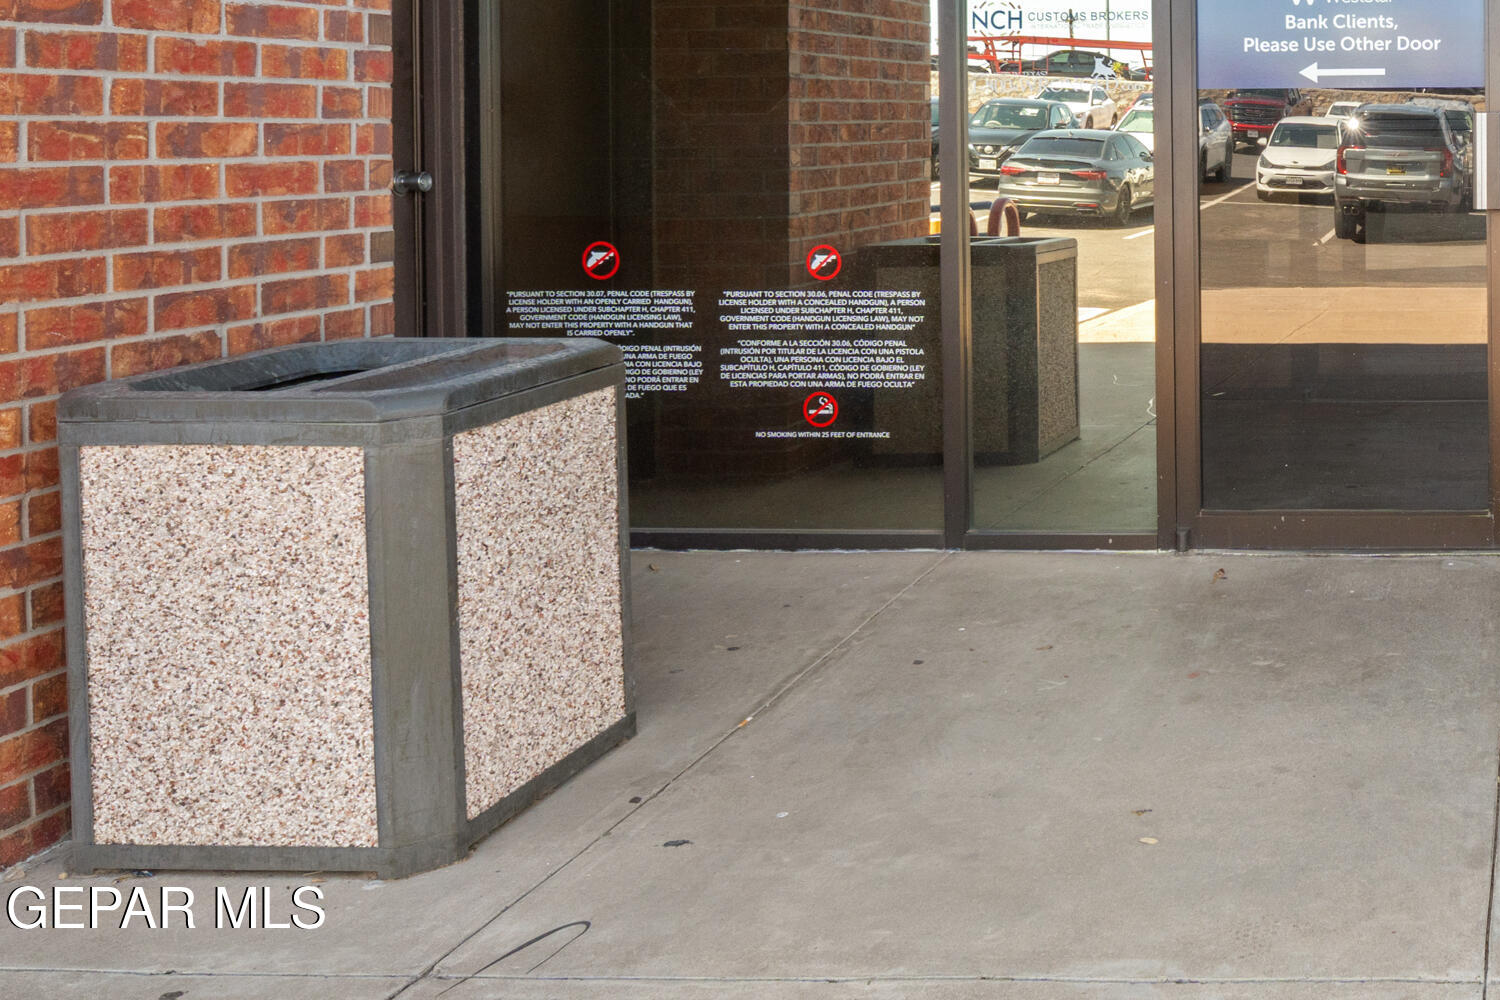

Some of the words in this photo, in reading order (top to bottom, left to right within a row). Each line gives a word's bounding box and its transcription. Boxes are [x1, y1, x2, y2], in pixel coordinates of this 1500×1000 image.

[972, 10, 1023, 30] NCH
[1027, 11, 1087, 22] CUSTOMS
[1090, 10, 1149, 21] BROKERS
[1285, 14, 1328, 30] Bank
[1332, 13, 1399, 31] Clients,
[1243, 36, 1299, 53] Please
[1303, 36, 1336, 52] Use
[1340, 35, 1393, 52] Other
[1396, 35, 1441, 51] Door
[775, 290, 806, 298] SECTION
[828, 290, 851, 298] PENAL
[852, 290, 873, 298] CODE
[719, 315, 769, 323] GOVERNMENT
[771, 315, 791, 323] CODE
[832, 315, 869, 323] LICENSING
[891, 315, 907, 323] MAY
[908, 315, 924, 323] NOT
[509, 321, 524, 329] MAY
[525, 321, 540, 329] NOT
[541, 321, 563, 329] ENTER
[565, 321, 578, 329] THIS
[580, 321, 612, 329] PROPERTY
[615, 321, 632, 329] WITH
[639, 321, 675, 329] HANDGUN
[675, 321, 693, 329] THAT
[641, 344, 662, 352] PENAL
[871, 364, 909, 372] GOBIERNO
